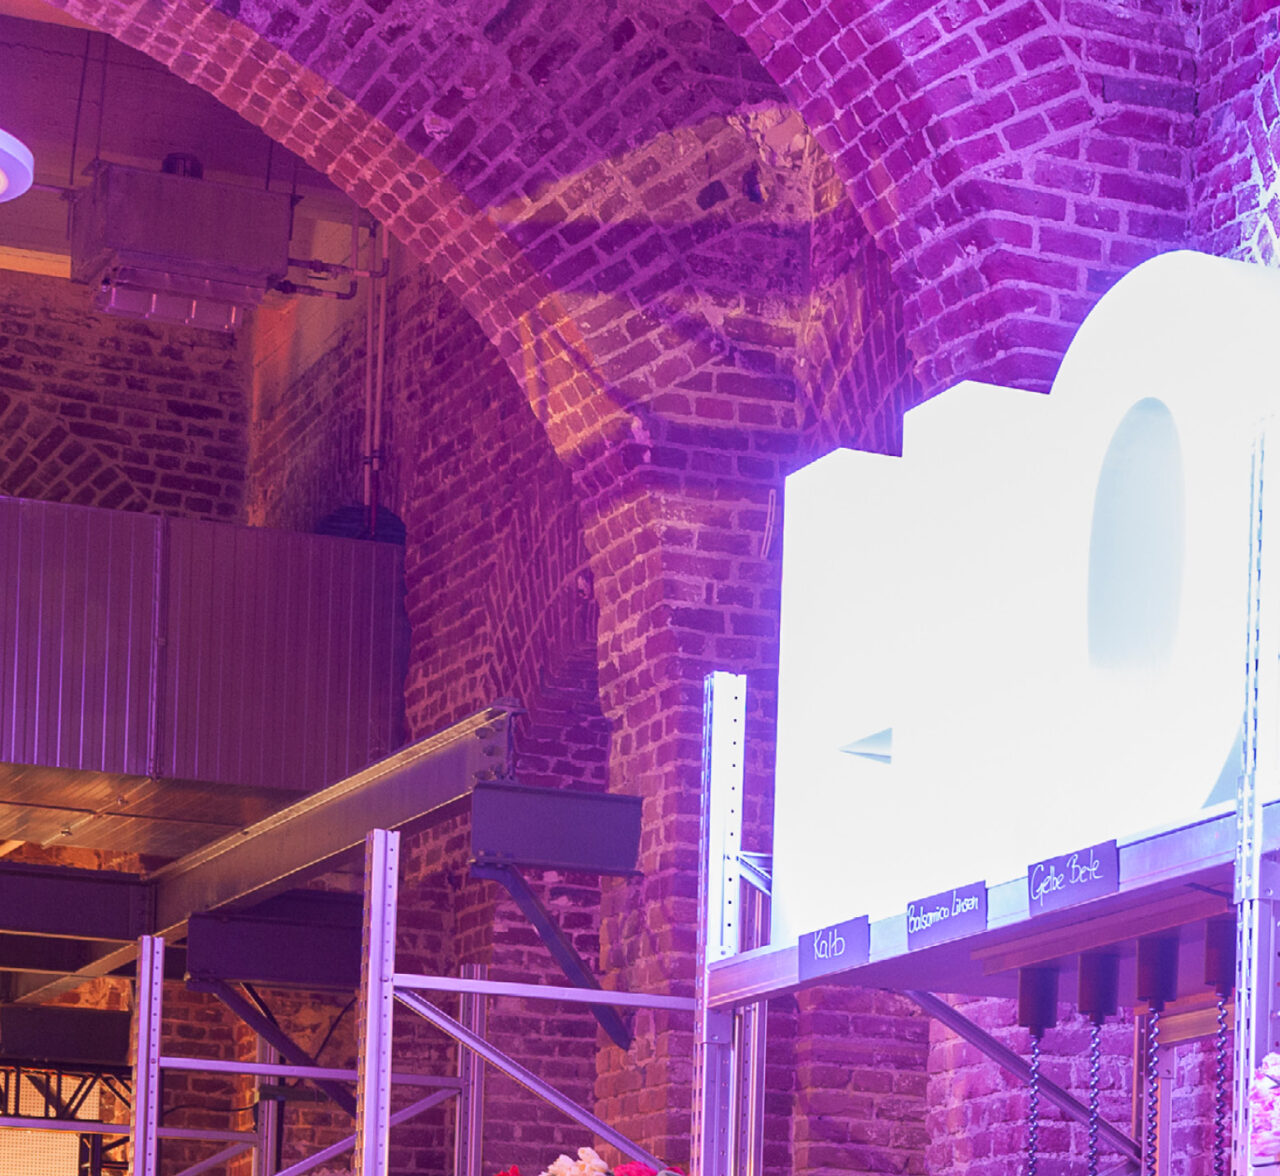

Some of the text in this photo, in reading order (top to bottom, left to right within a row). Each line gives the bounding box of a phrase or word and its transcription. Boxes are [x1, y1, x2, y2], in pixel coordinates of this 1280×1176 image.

[1030, 849, 1104, 907] Gelbe Bete
[951, 889, 979, 916] Linsen
[814, 928, 846, 960] Kalb
